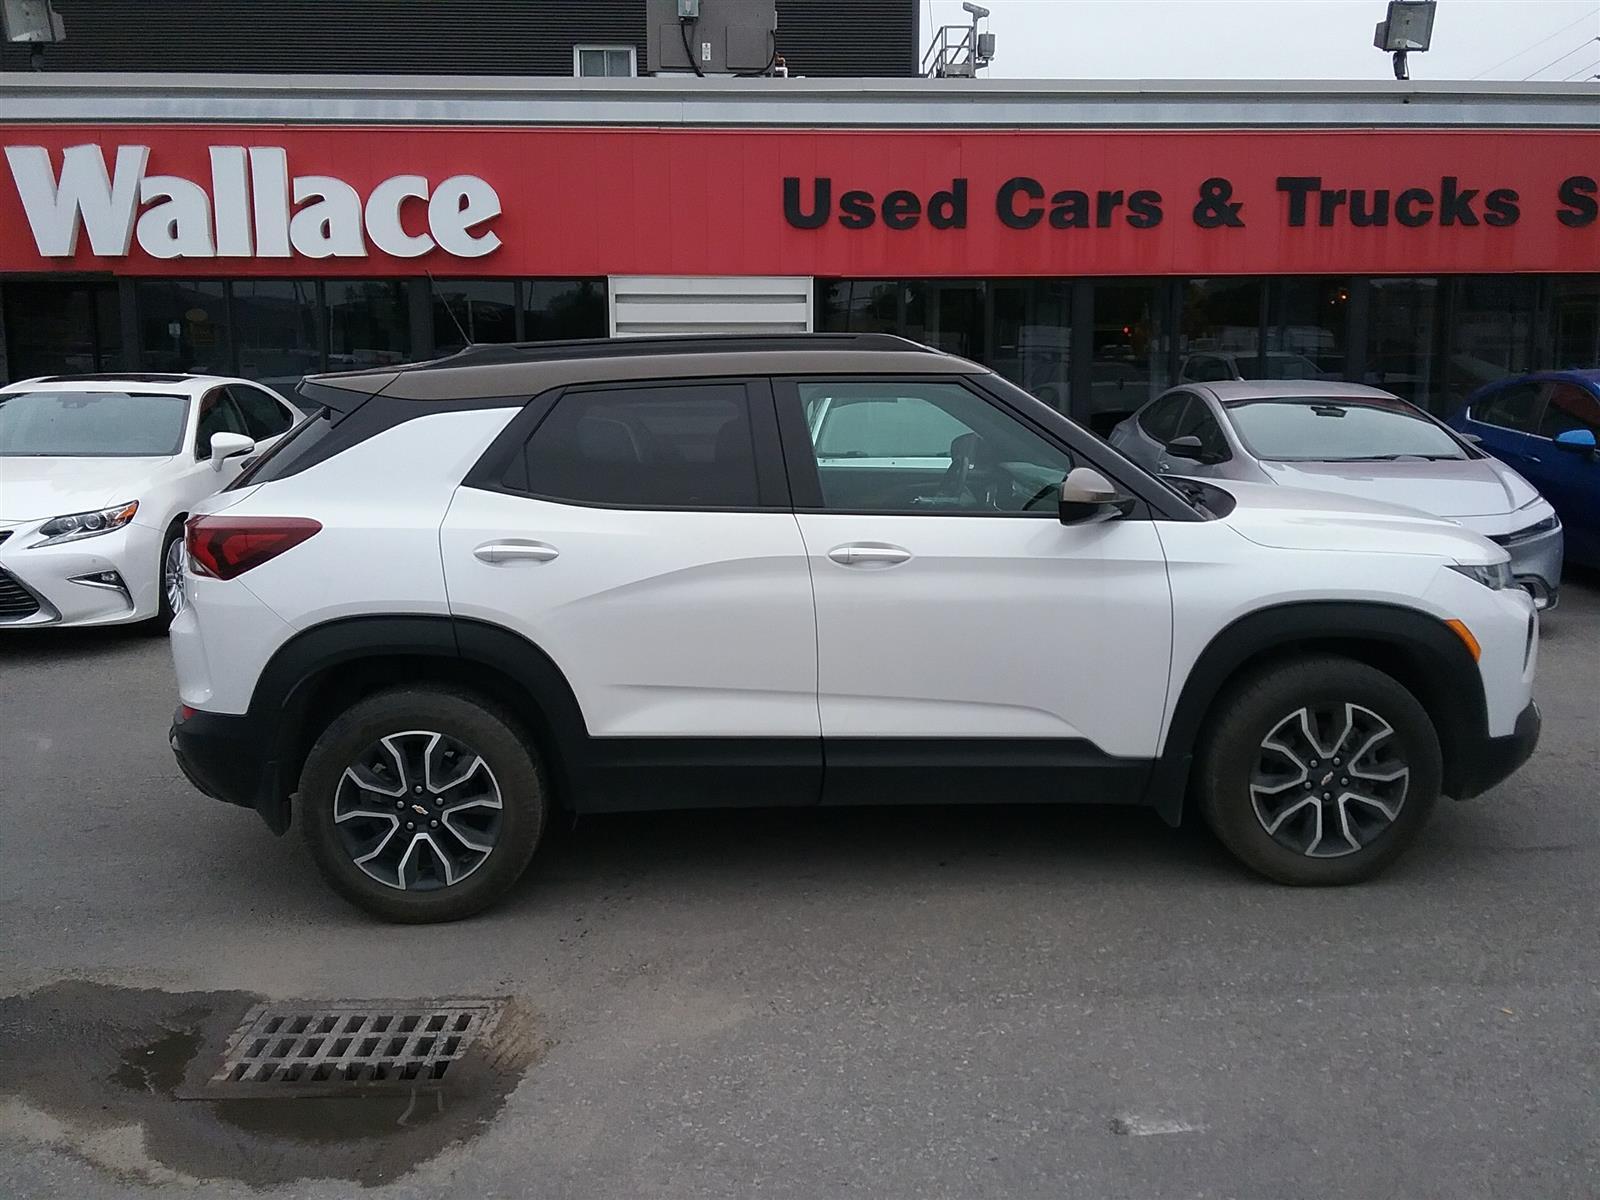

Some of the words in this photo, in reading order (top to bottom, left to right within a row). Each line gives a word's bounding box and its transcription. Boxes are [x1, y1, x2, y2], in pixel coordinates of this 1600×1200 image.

[5, 143, 502, 259] Wallace
[784, 178, 967, 229] Used
[997, 178, 1163, 229] Cars
[1193, 179, 1243, 229] &
[1277, 177, 1519, 228] Trucks
